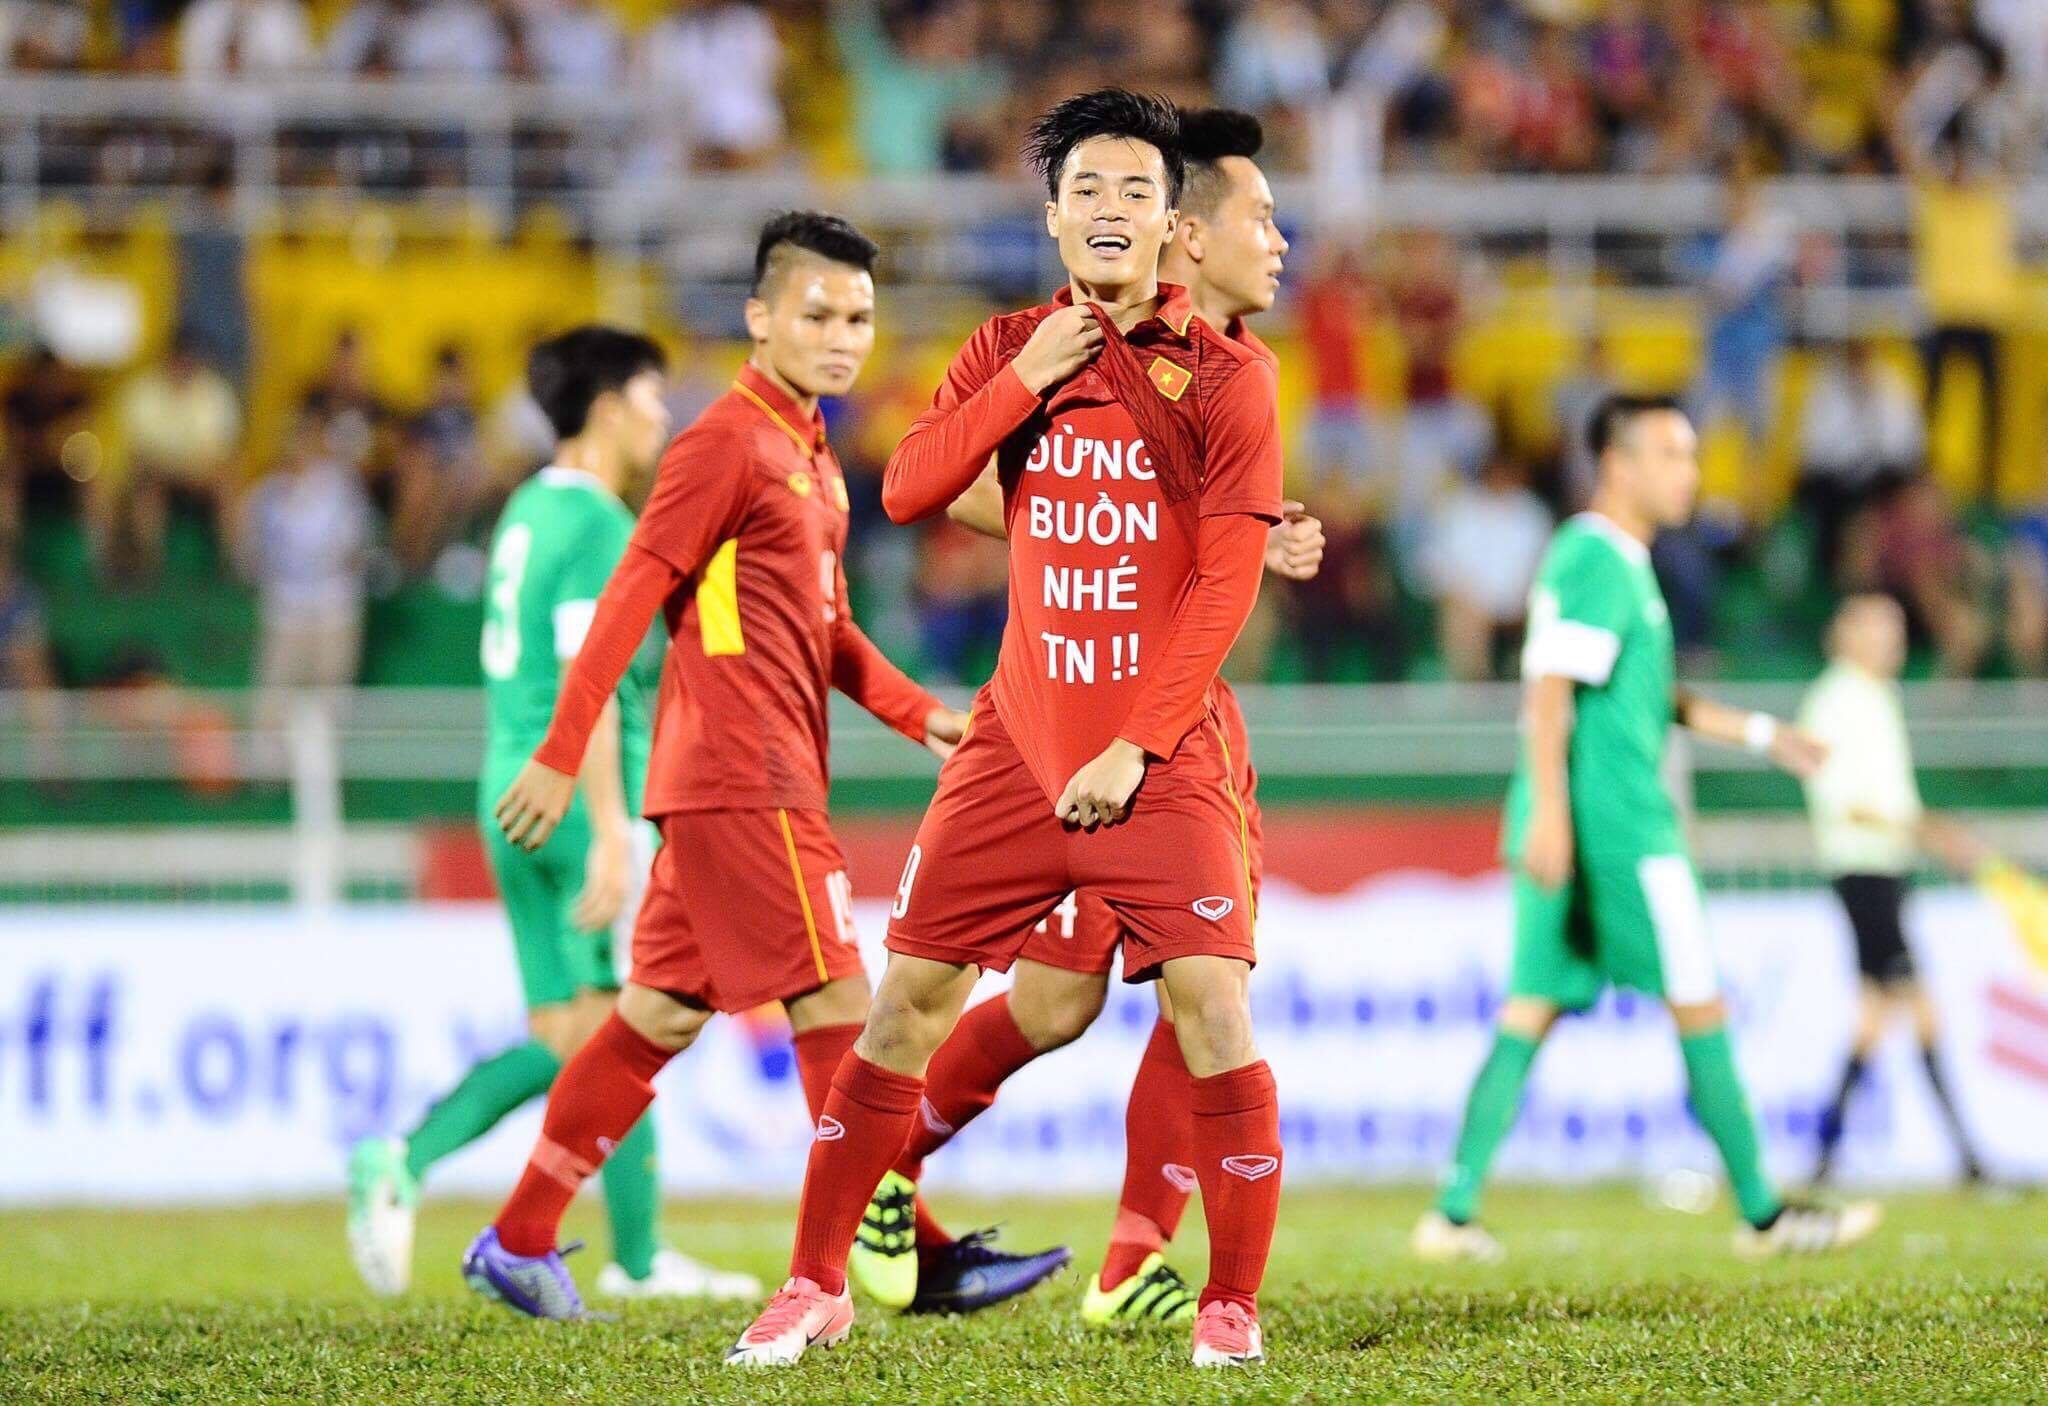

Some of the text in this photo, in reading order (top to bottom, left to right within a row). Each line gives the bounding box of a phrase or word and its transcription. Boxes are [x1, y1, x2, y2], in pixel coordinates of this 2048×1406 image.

[1030, 491, 1158, 546] BUỒN
[481, 523, 531, 679] 3
[1043, 555, 1138, 611] NHÉ
[1041, 631, 1139, 684] TN !!
[891, 844, 921, 919] 9
